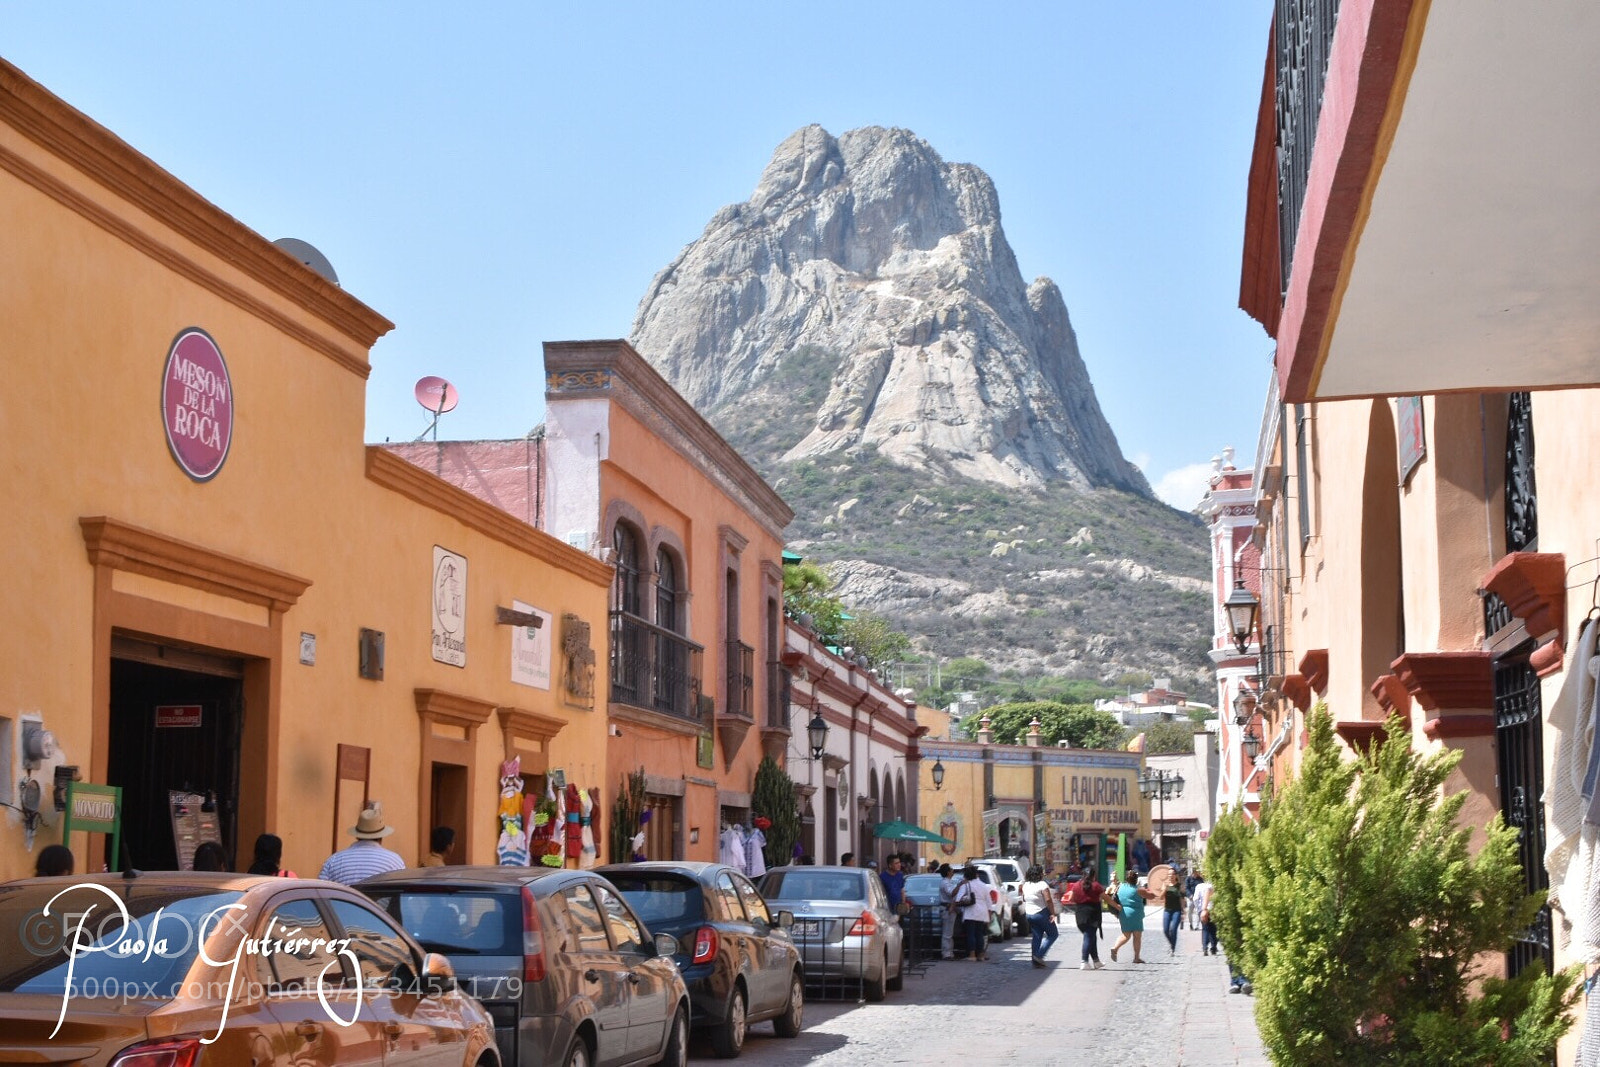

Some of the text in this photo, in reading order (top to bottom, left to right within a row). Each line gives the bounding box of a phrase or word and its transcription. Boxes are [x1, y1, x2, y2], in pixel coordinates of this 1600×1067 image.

[183, 386, 216, 418] DE LA
[174, 404, 221, 451] ROCA
[74, 799, 115, 819] MONOLITO
[1050, 809, 1140, 824] CENTRO ARTESANAL
